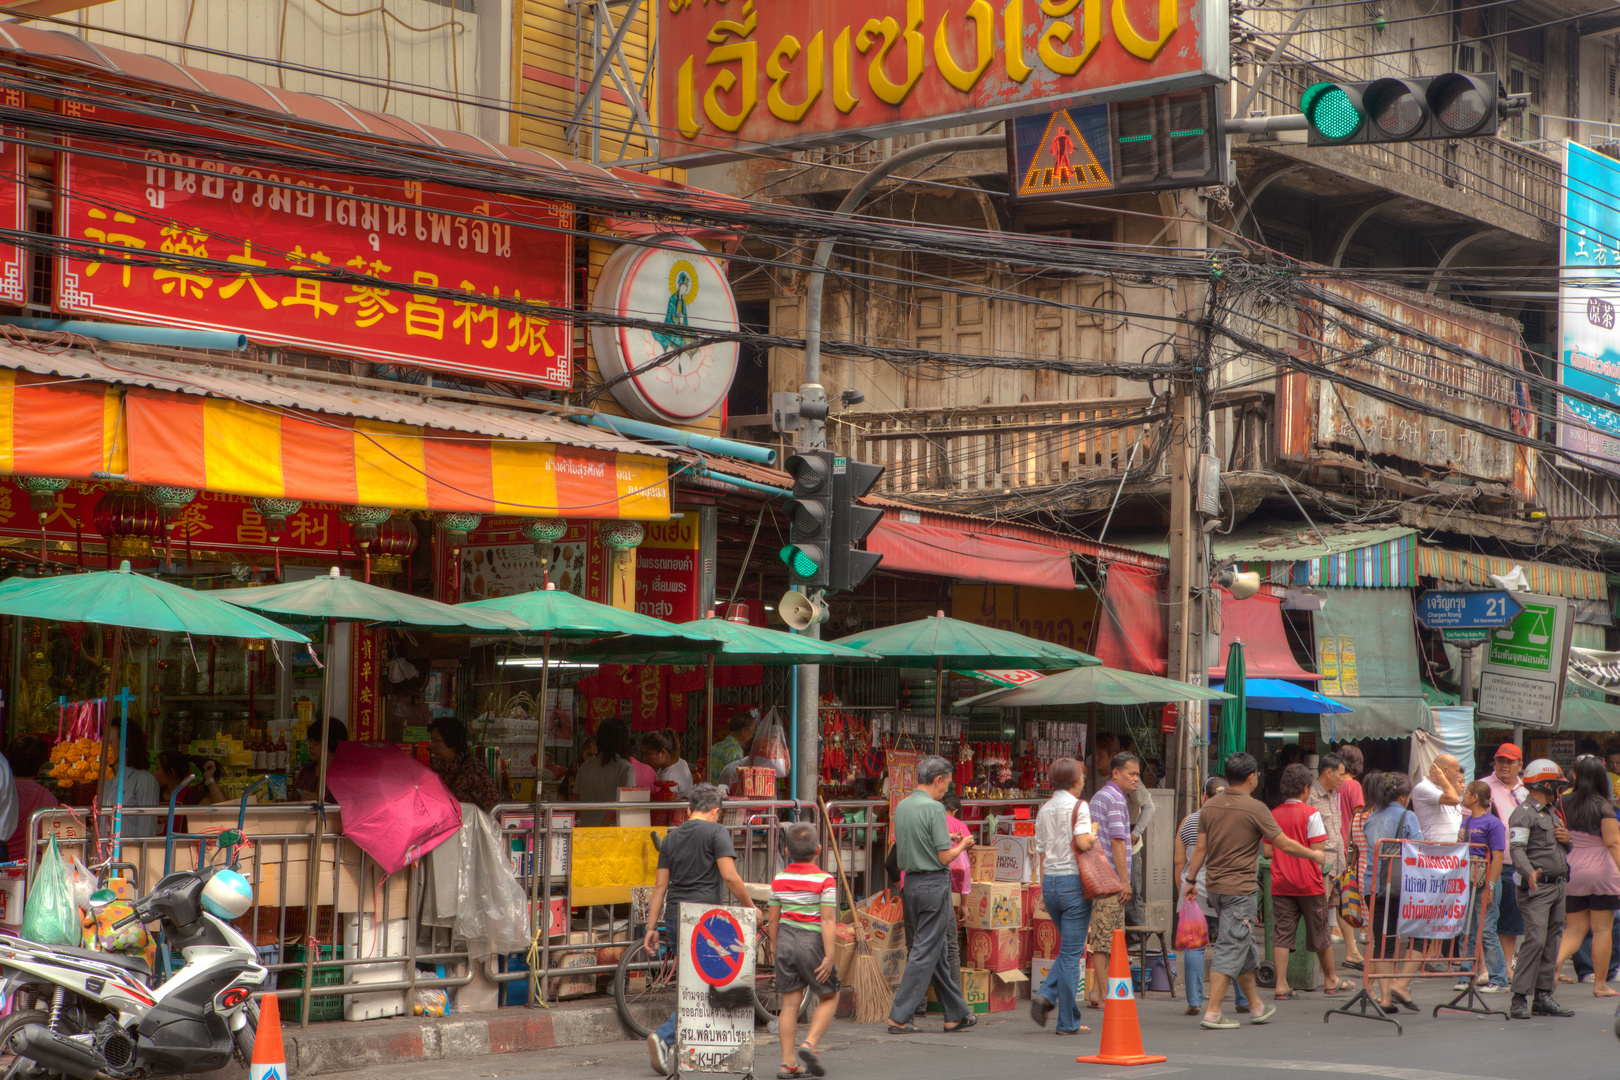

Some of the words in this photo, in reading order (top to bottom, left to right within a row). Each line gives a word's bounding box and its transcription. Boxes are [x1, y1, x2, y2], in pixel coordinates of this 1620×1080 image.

[652, 575, 687, 593] เลี่ยมพระ
[1427, 594, 1466, 612] เจริญกรุง
[1486, 597, 1506, 617] 21
[1040, 930, 1054, 938] LEO
[973, 941, 989, 949] LEO
